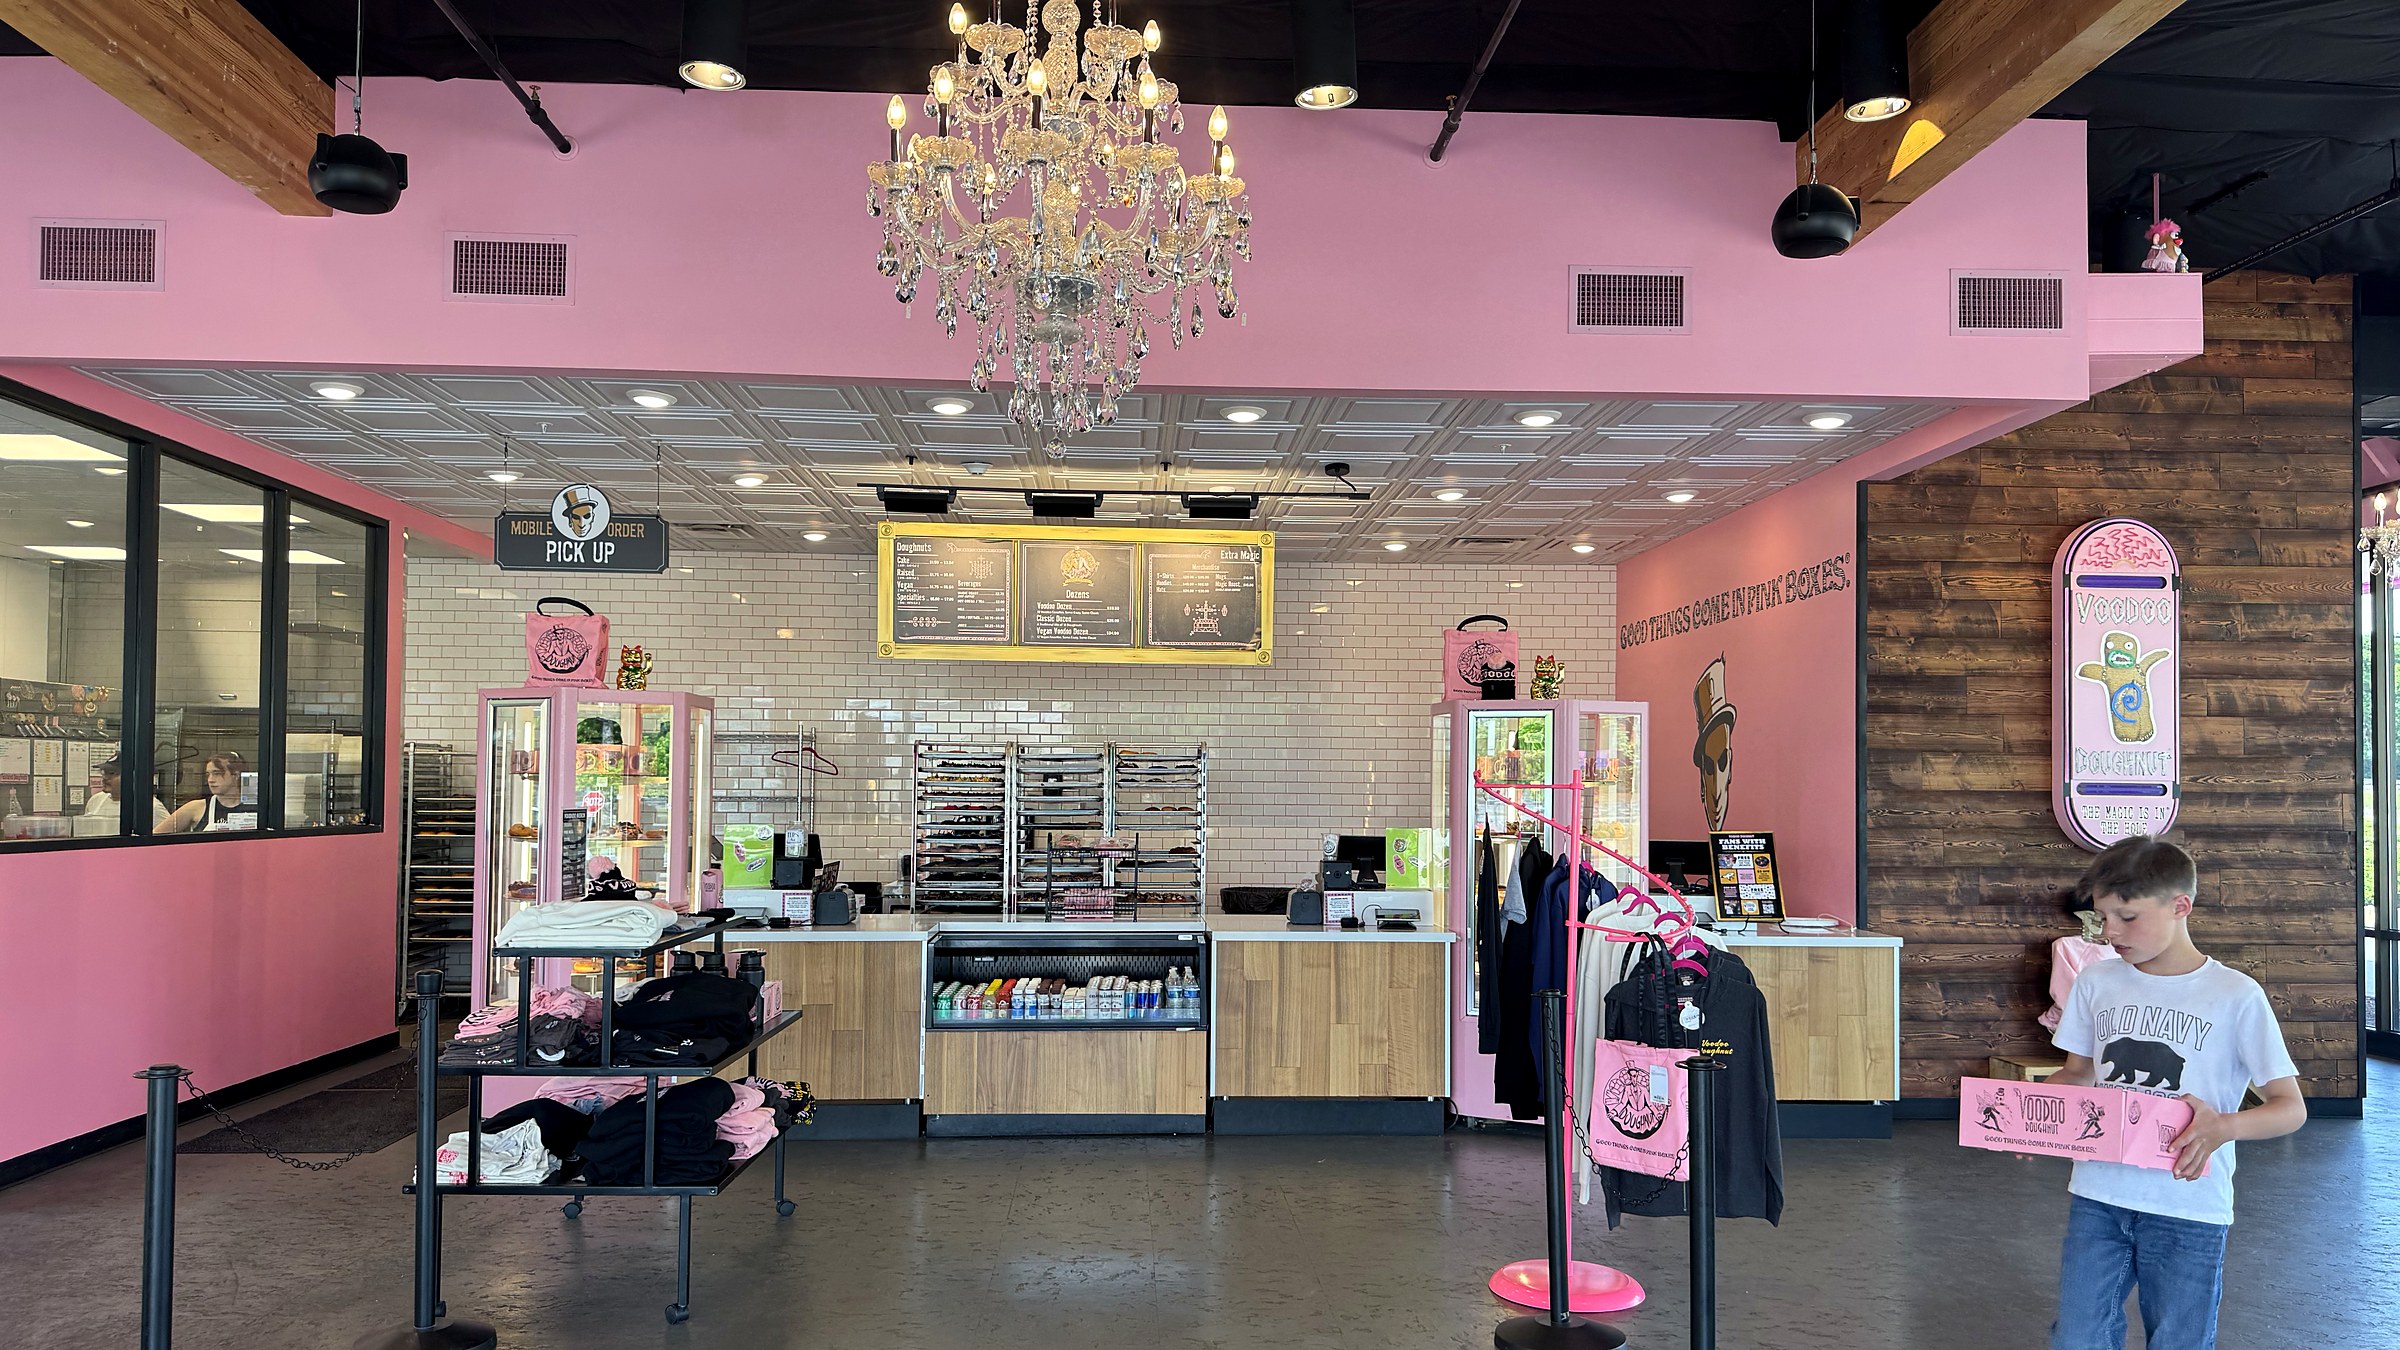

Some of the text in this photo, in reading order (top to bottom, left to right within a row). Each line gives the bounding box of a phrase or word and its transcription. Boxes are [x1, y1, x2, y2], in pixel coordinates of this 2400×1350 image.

[511, 520, 645, 538] MOBILE ORDER
[546, 540, 616, 564] PICK UP
[896, 541, 932, 553] Doughnuts
[1220, 550, 1260, 562] Extra Magic
[1066, 589, 1090, 599] Dozens
[1620, 619, 1648, 650] GOOD
[1648, 605, 1691, 643] THINGS
[1692, 591, 1731, 630] COME
[1731, 586, 1747, 619] IN
[1747, 574, 1783, 616] PINK
[2075, 591, 2172, 626] VOODOO
[2075, 746, 2172, 777] DOUGHNUT
[2082, 805, 2166, 820] THE MAGIC IS IN
[2101, 821, 2119, 835] THE
[2095, 1005, 2213, 1051] OLD NAVY
[1701, 1039, 1729, 1047] Voodoo
[2013, 1087, 2065, 1125] VOODOO
[2024, 1121, 2059, 1136] DOUGHNUT
[1984, 1135, 2003, 1143] GOOD
[2003, 1137, 2027, 1146] THINGS
[2027, 1139, 2047, 1148] COME
[2047, 1141, 2055, 1149] IN
[2055, 1142, 2071, 1151] PINK
